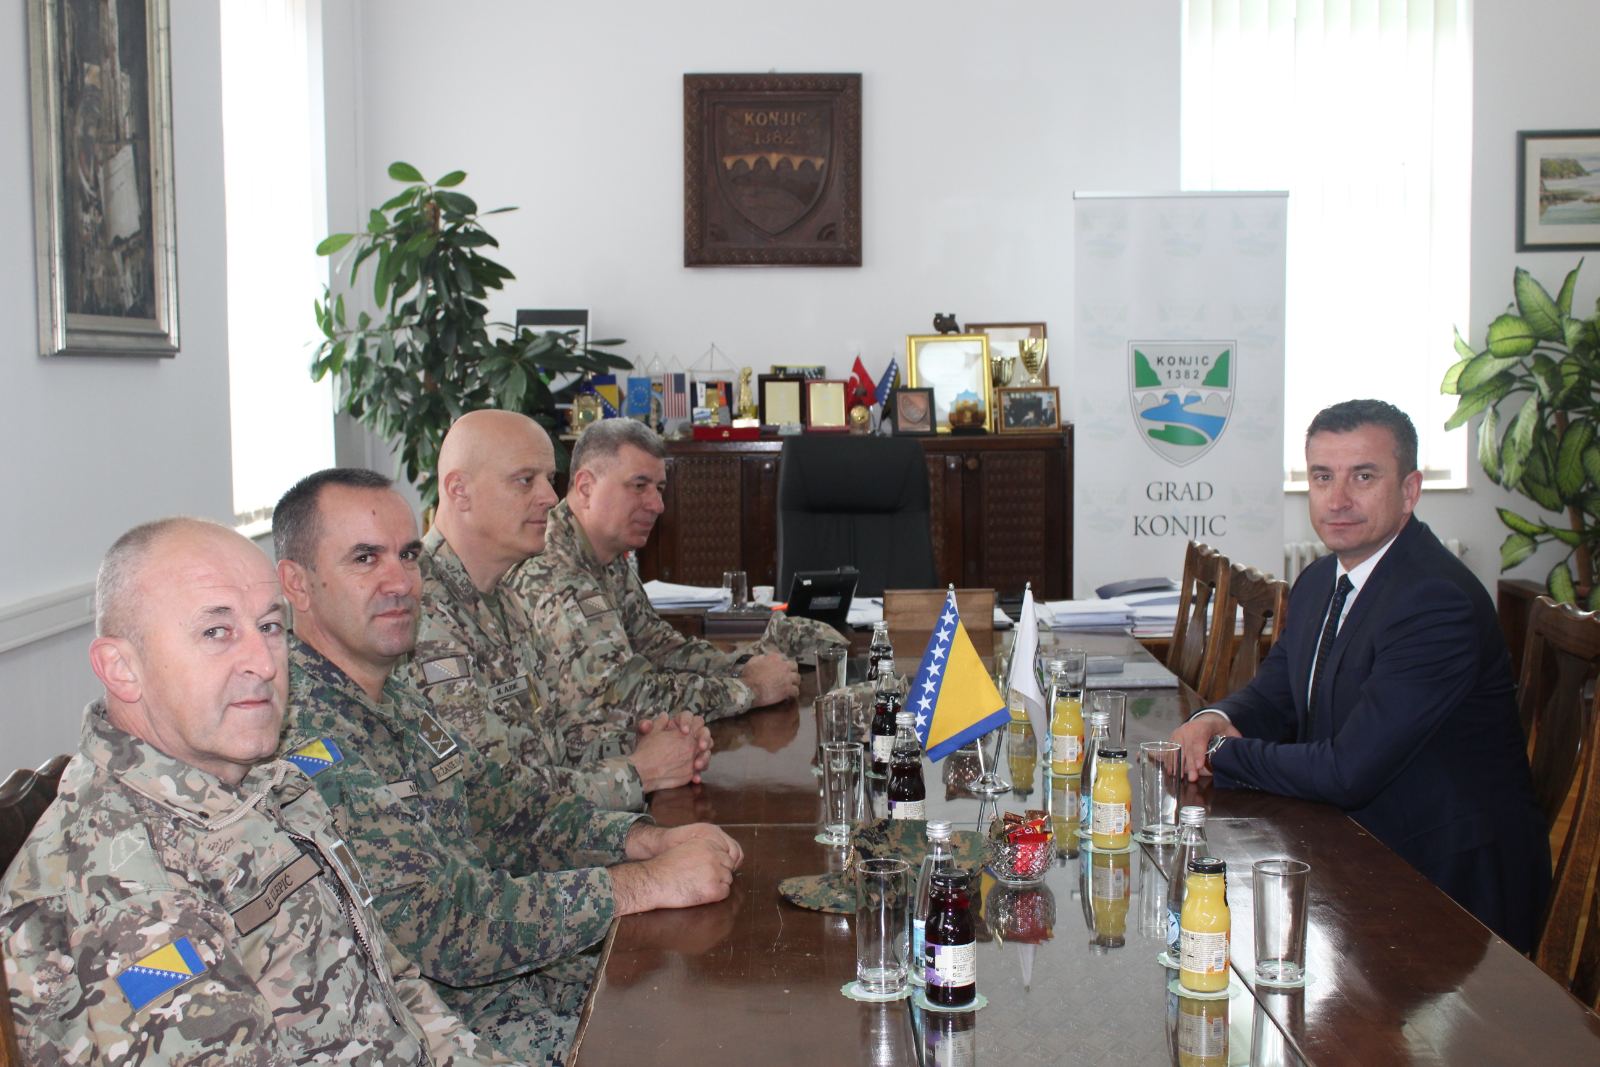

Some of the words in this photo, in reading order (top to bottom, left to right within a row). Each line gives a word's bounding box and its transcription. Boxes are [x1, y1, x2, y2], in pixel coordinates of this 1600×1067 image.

[744, 112, 808, 126] KONJIC
[753, 131, 795, 145] 1382
[1156, 355, 1210, 366] KONJIC
[1166, 369, 1200, 380] 1382
[1146, 481, 1213, 502] GRAD
[1133, 515, 1227, 539] KONJIC
